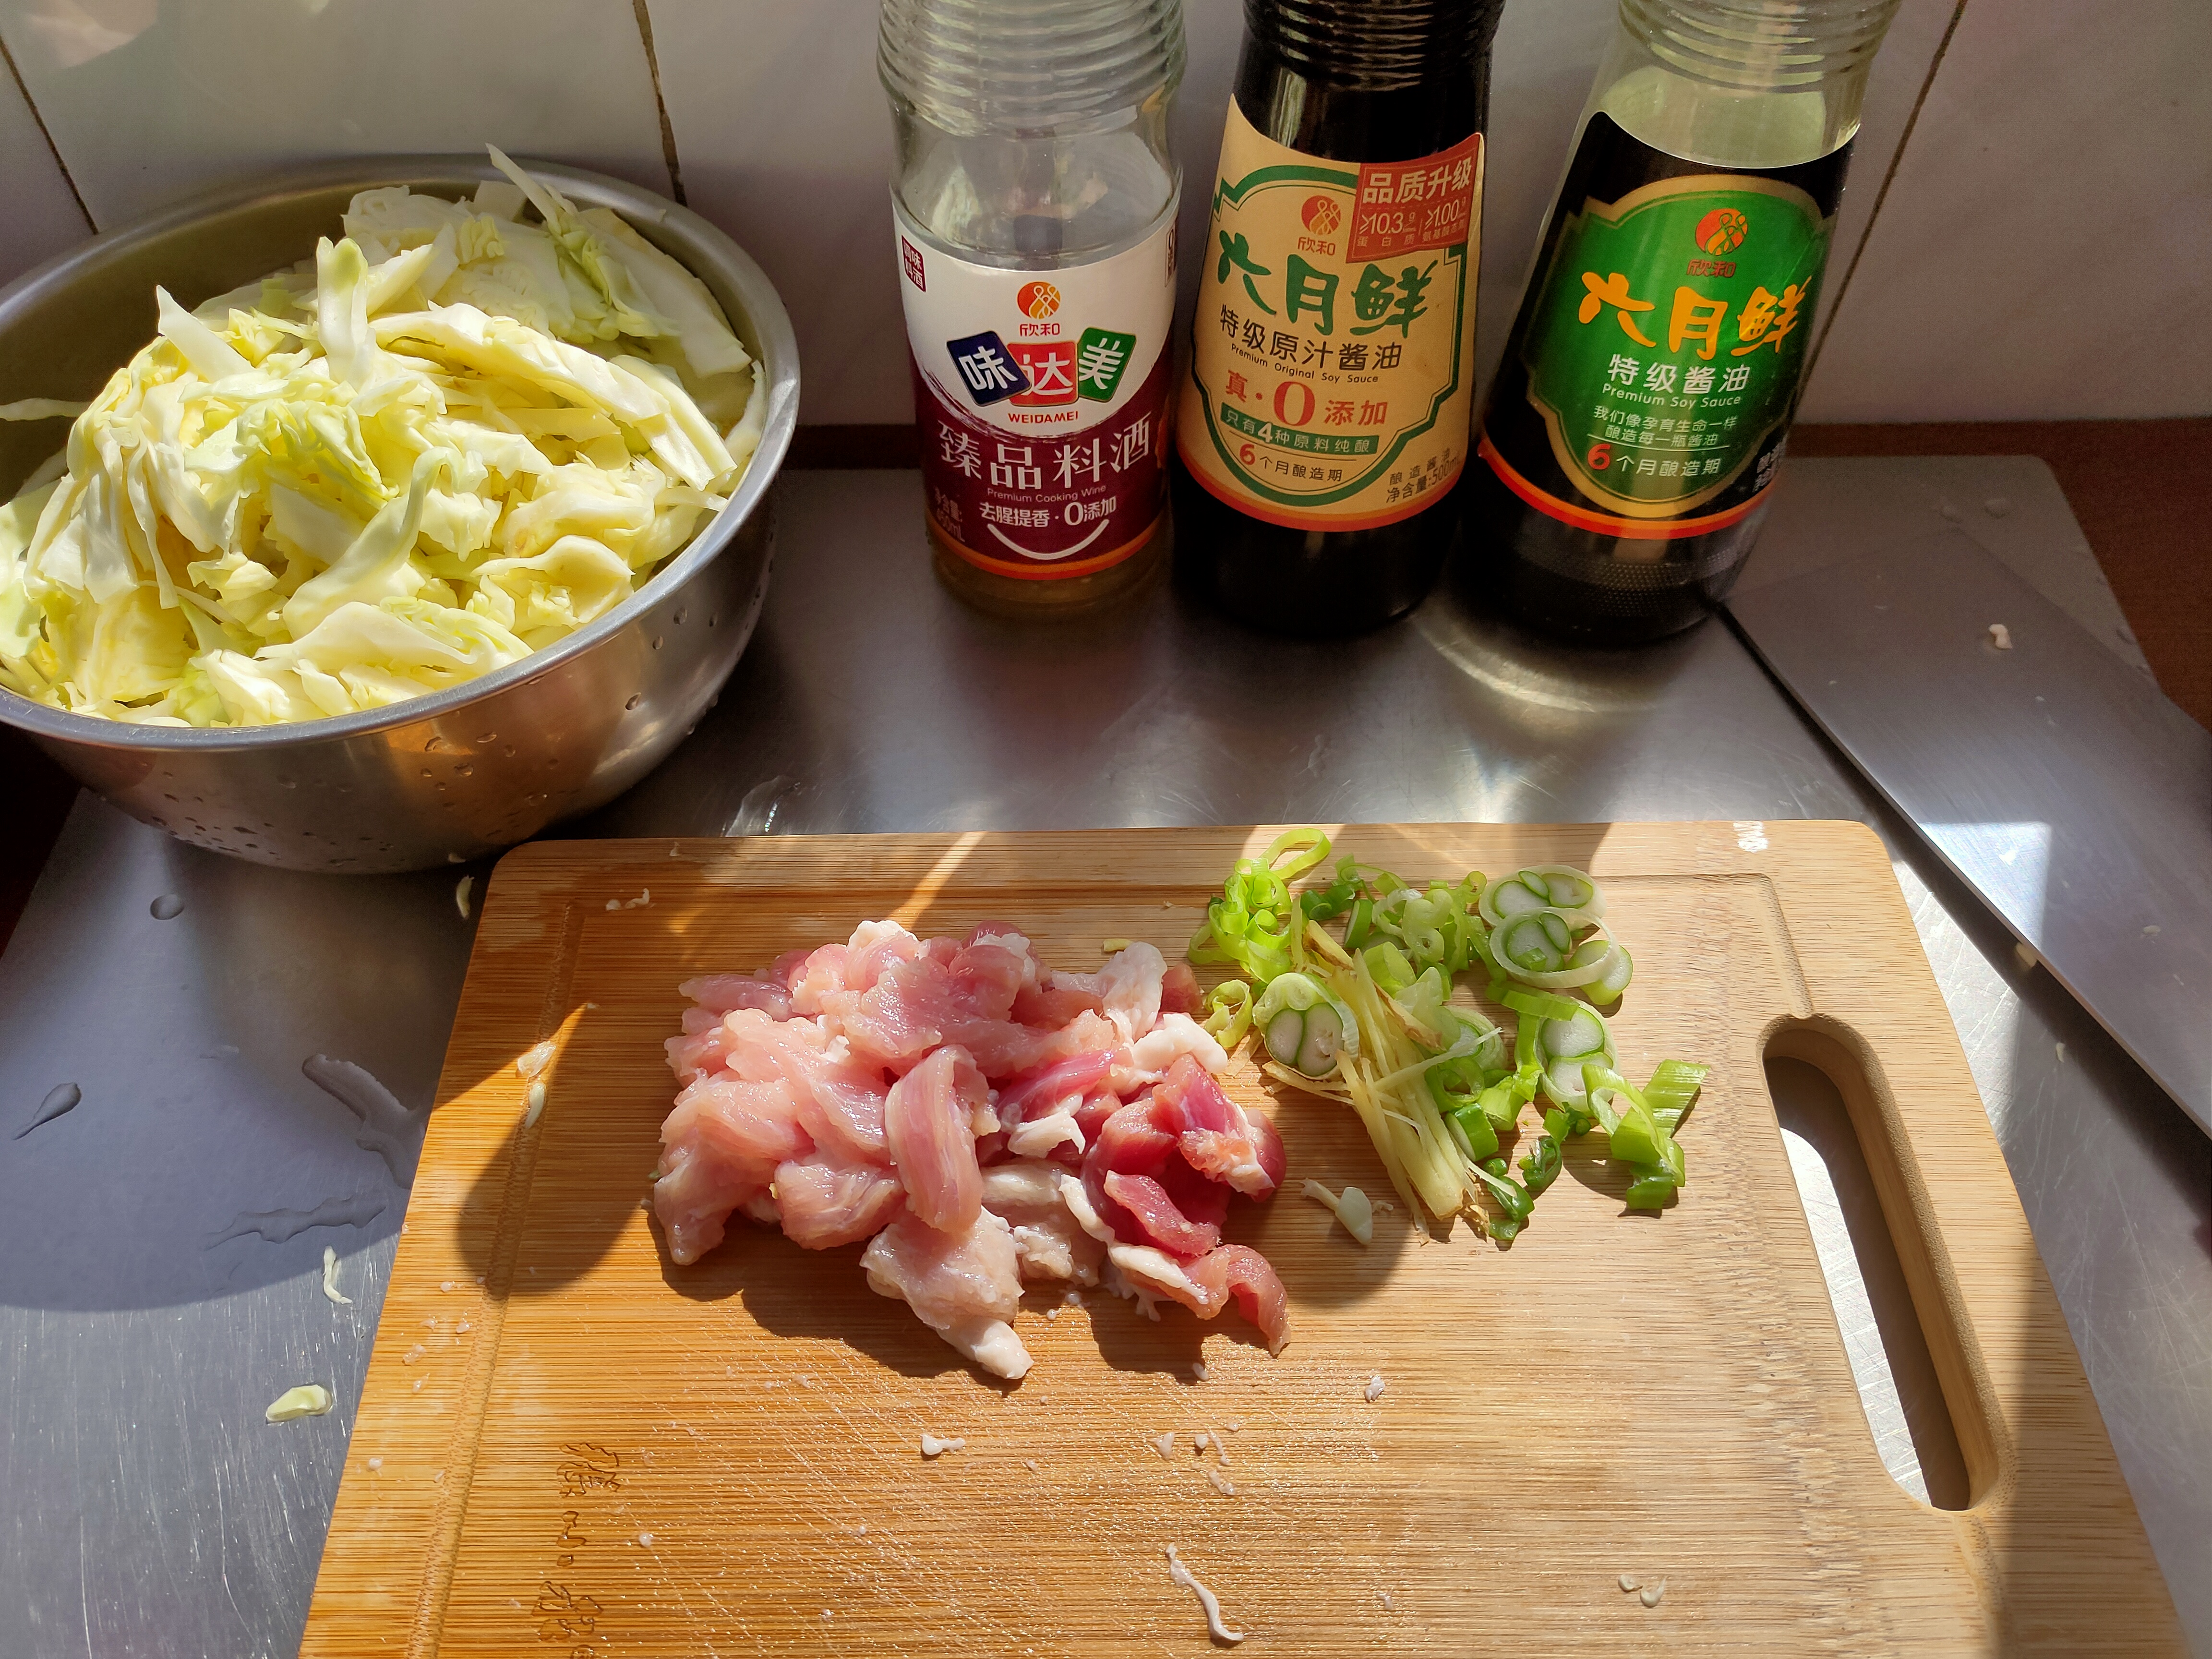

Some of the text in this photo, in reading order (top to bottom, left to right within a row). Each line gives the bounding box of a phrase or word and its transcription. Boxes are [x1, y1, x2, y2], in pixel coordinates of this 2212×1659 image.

[1362, 156, 1472, 204] 品质升级
[1359, 212, 1404, 235] ≥10.3
[1298, 237, 1335, 256] 欣和
[1217, 230, 1438, 338] 六月鲜
[1686, 259, 1737, 277] 欣和
[1020, 323, 1060, 337] 欣和
[1578, 271, 1812, 361] 六月鲜
[1220, 304, 1402, 372] 特级原汁酱油
[958, 337, 1125, 397] 味达美
[1231, 343, 1378, 384] Premium Original Soy Sauce
[1607, 353, 1751, 395] 特级酱油
[1602, 383, 1742, 410] Premium Soy Sauce
[1008, 410, 1079, 424] WEIDAMEI
[1226, 409, 1370, 453] 只有4种原料纯酿
[1593, 405, 1738, 433] 我们像孕育生命一样
[938, 411, 1152, 490] 臻品料酒
[1605, 424, 1719, 448] 酿造每一瓶酱油
[1239, 443, 1343, 482] 6个月酿造期
[1587, 444, 1721, 477] 6个月酿造期
[987, 485, 1106, 503] Premium Cooking Wine
